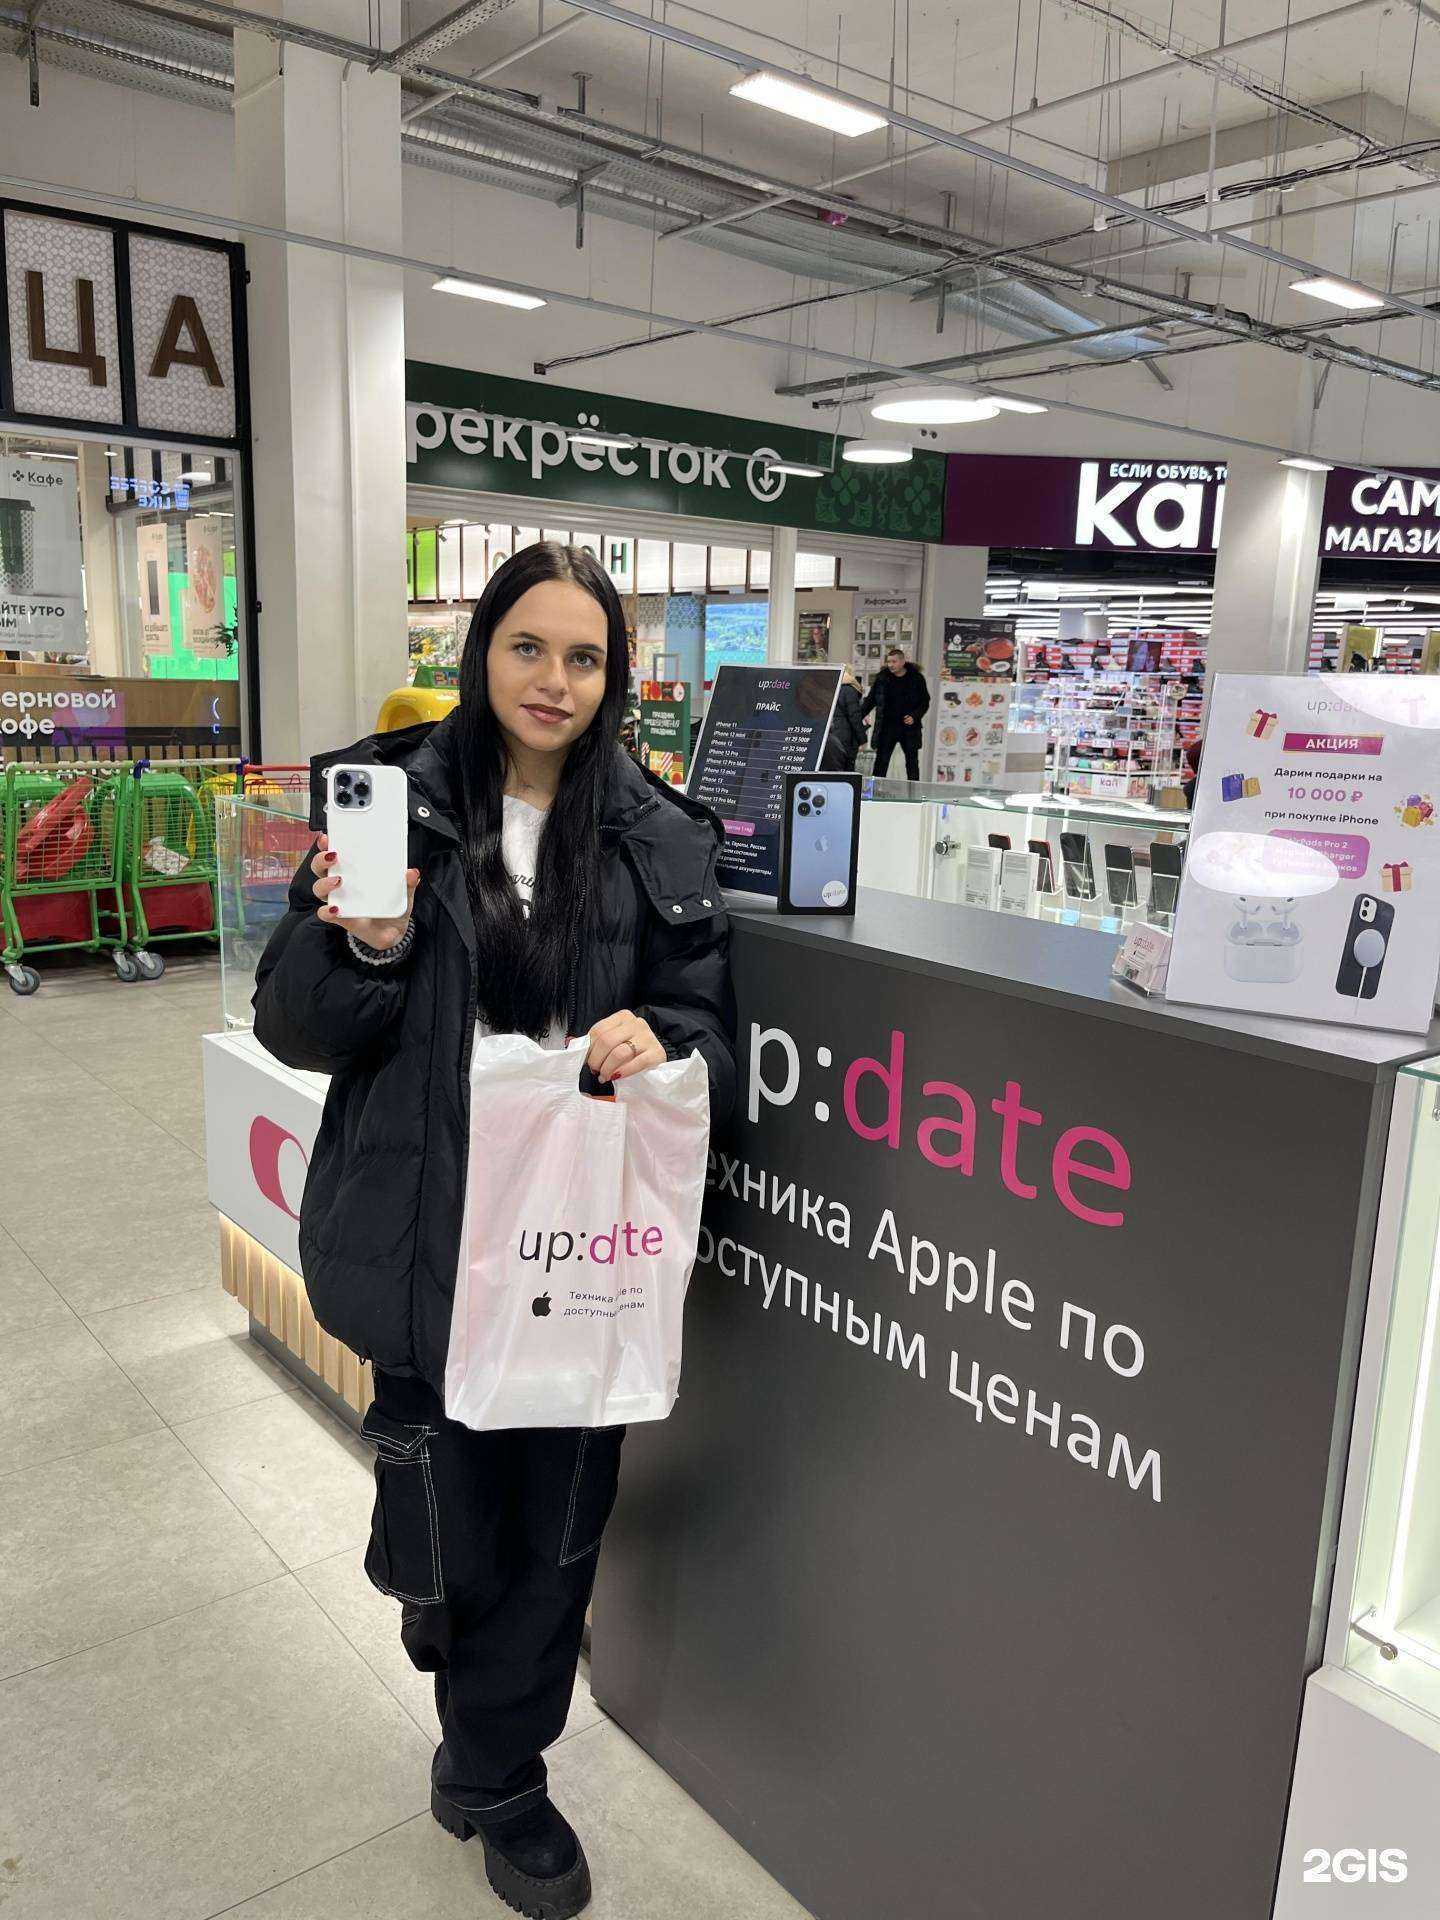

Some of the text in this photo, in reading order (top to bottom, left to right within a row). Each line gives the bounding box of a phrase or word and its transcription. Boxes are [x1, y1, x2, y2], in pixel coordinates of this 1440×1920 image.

[28, 471, 64, 487] Кафе
[1109, 463, 1153, 479] ЕСЛИ
[1156, 464, 1212, 482] ОБУВЬ,
[0, 602, 65, 617] ЙТЕ УТРО
[864, 598, 907, 606] Информация
[758, 680, 791, 690] up:date
[0, 688, 117, 713] ерновой
[755, 701, 781, 712] ПРАЙС
[1306, 699, 1361, 714] up:da
[1306, 738, 1359, 750] АКЦИЯ
[1274, 768, 1383, 783] Дарим подарки на
[1287, 787, 1305, 799] 10
[1310, 788, 1347, 802] 000
[1264, 811, 1379, 825] при покупке iPhone
[1324, 840, 1340, 848] Pro
[1342, 841, 1349, 849] 2
[747, 1022, 1132, 1227] p:date
[519, 1221, 663, 1273] up:dte
[705, 1155, 1145, 1378] ехника Apple по
[569, 1291, 614, 1304] Техника
[629, 1286, 643, 1295] по
[619, 1301, 645, 1312] енам
[696, 1226, 1163, 1503] оступным ценам
